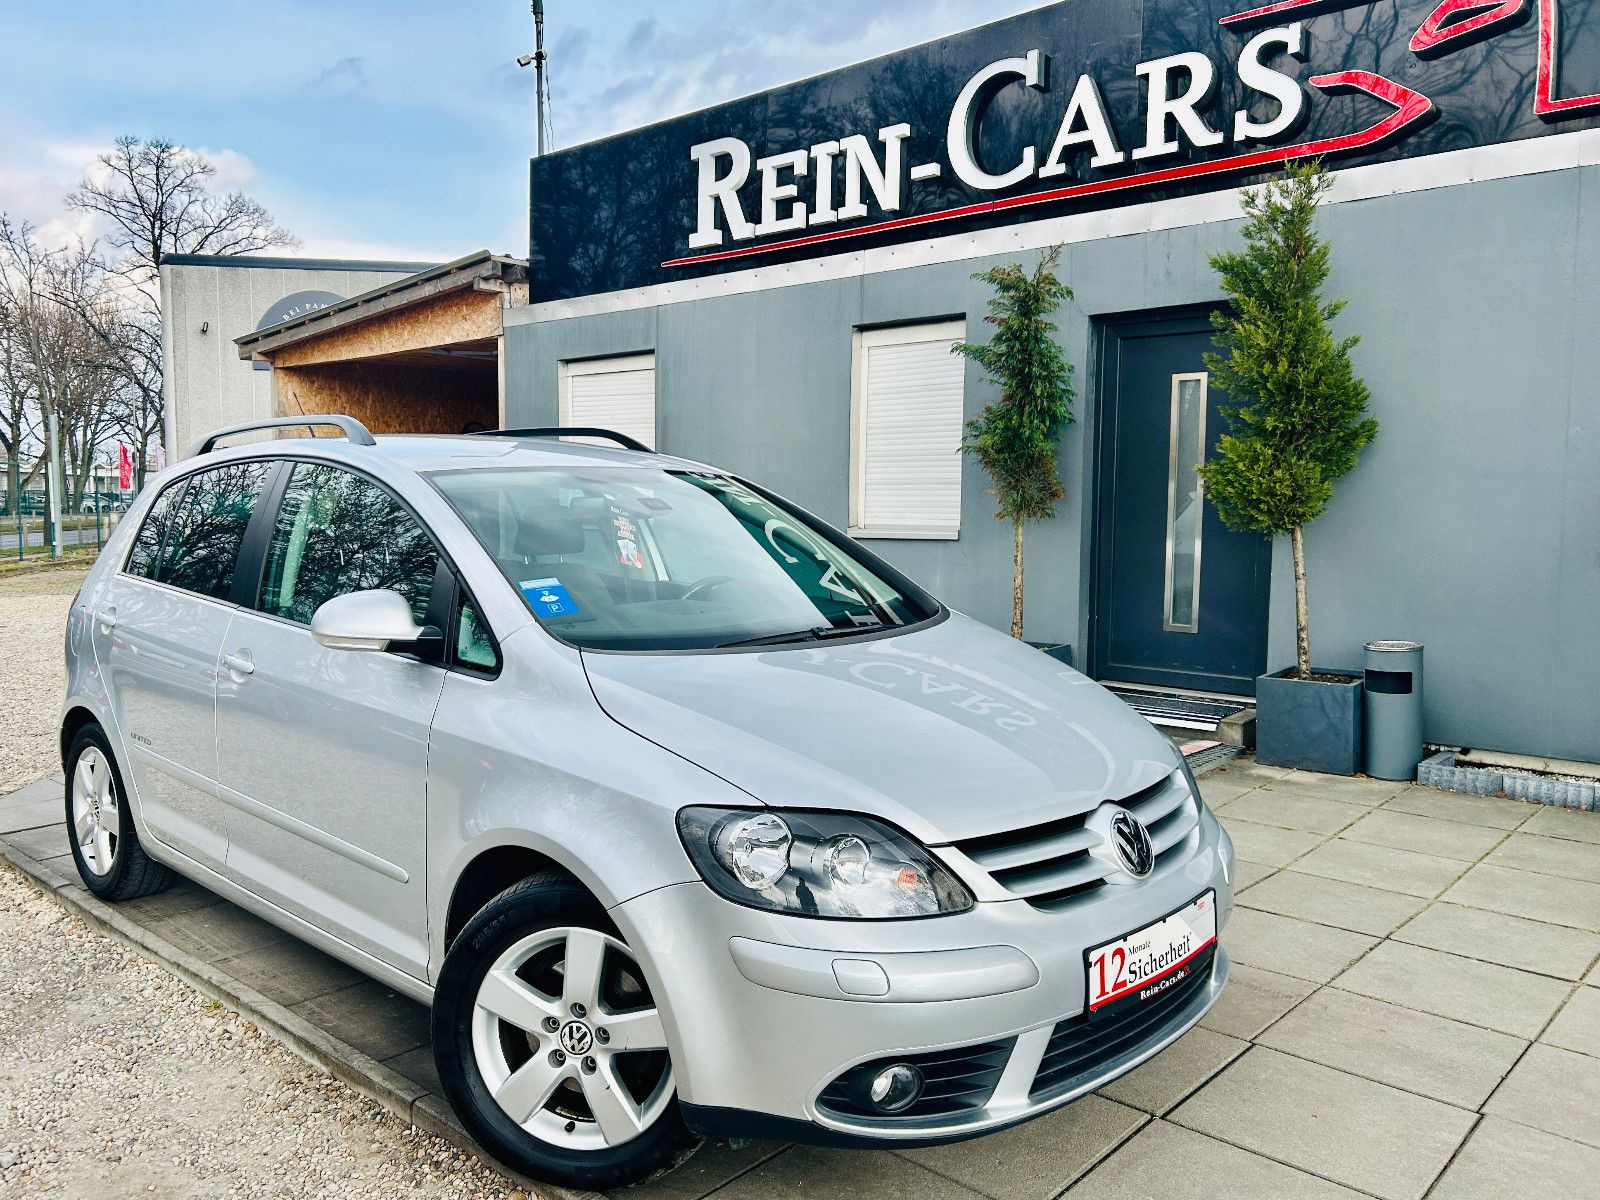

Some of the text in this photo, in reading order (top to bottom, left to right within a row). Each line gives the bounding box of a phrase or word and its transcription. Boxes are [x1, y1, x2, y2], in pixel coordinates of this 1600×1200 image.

[688, 22, 1303, 249] REIN-CARS
[130, 732, 152, 746] UNITED
[1093, 946, 1128, 1000] 12
